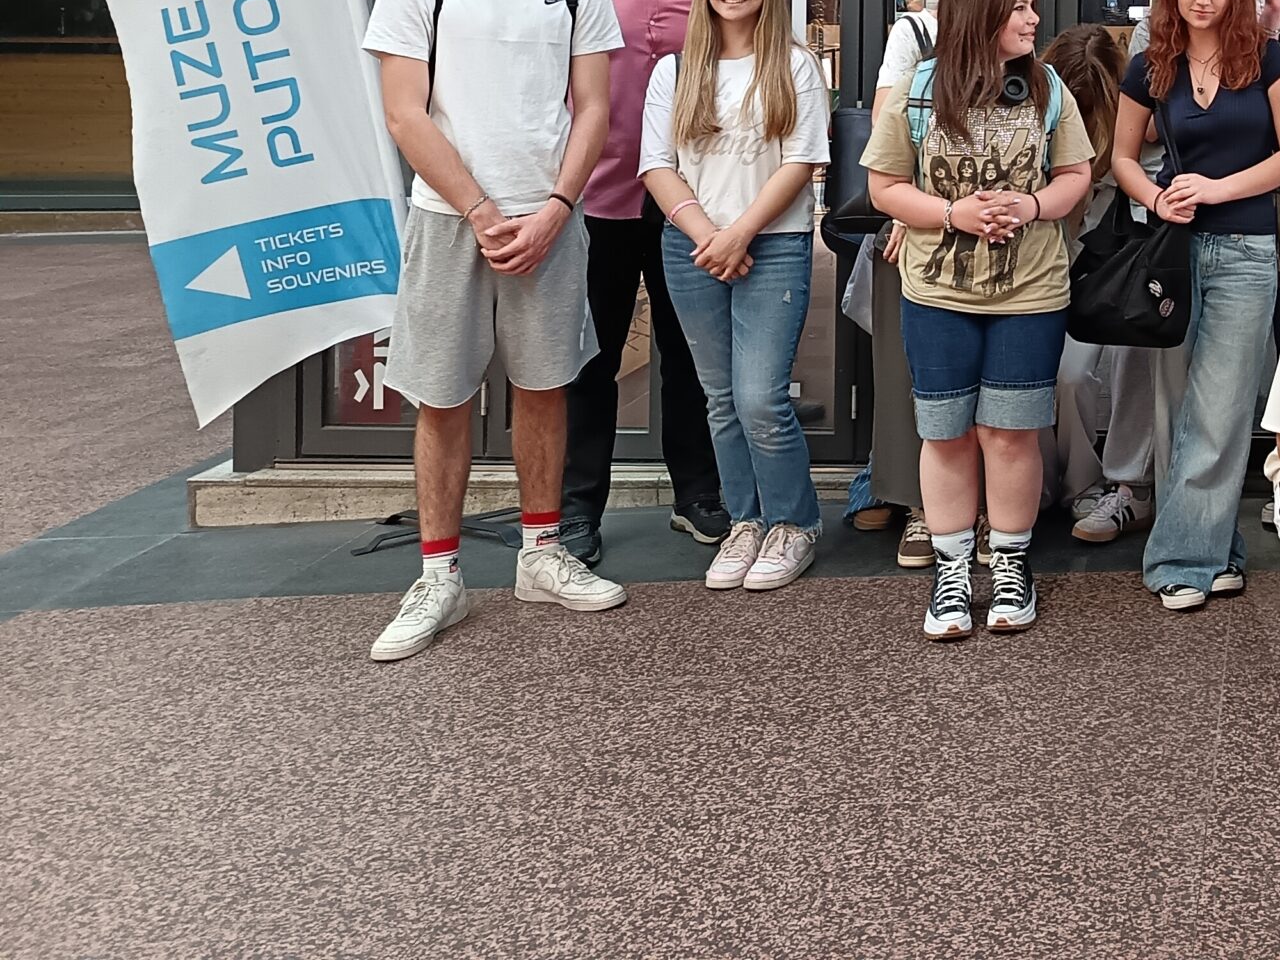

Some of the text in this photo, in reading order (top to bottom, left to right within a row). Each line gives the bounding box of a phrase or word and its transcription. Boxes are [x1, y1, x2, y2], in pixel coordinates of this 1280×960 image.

[254, 221, 344, 252] TICKETS
[260, 250, 312, 274] INFO
[266, 257, 388, 294] SOUVENIRS
